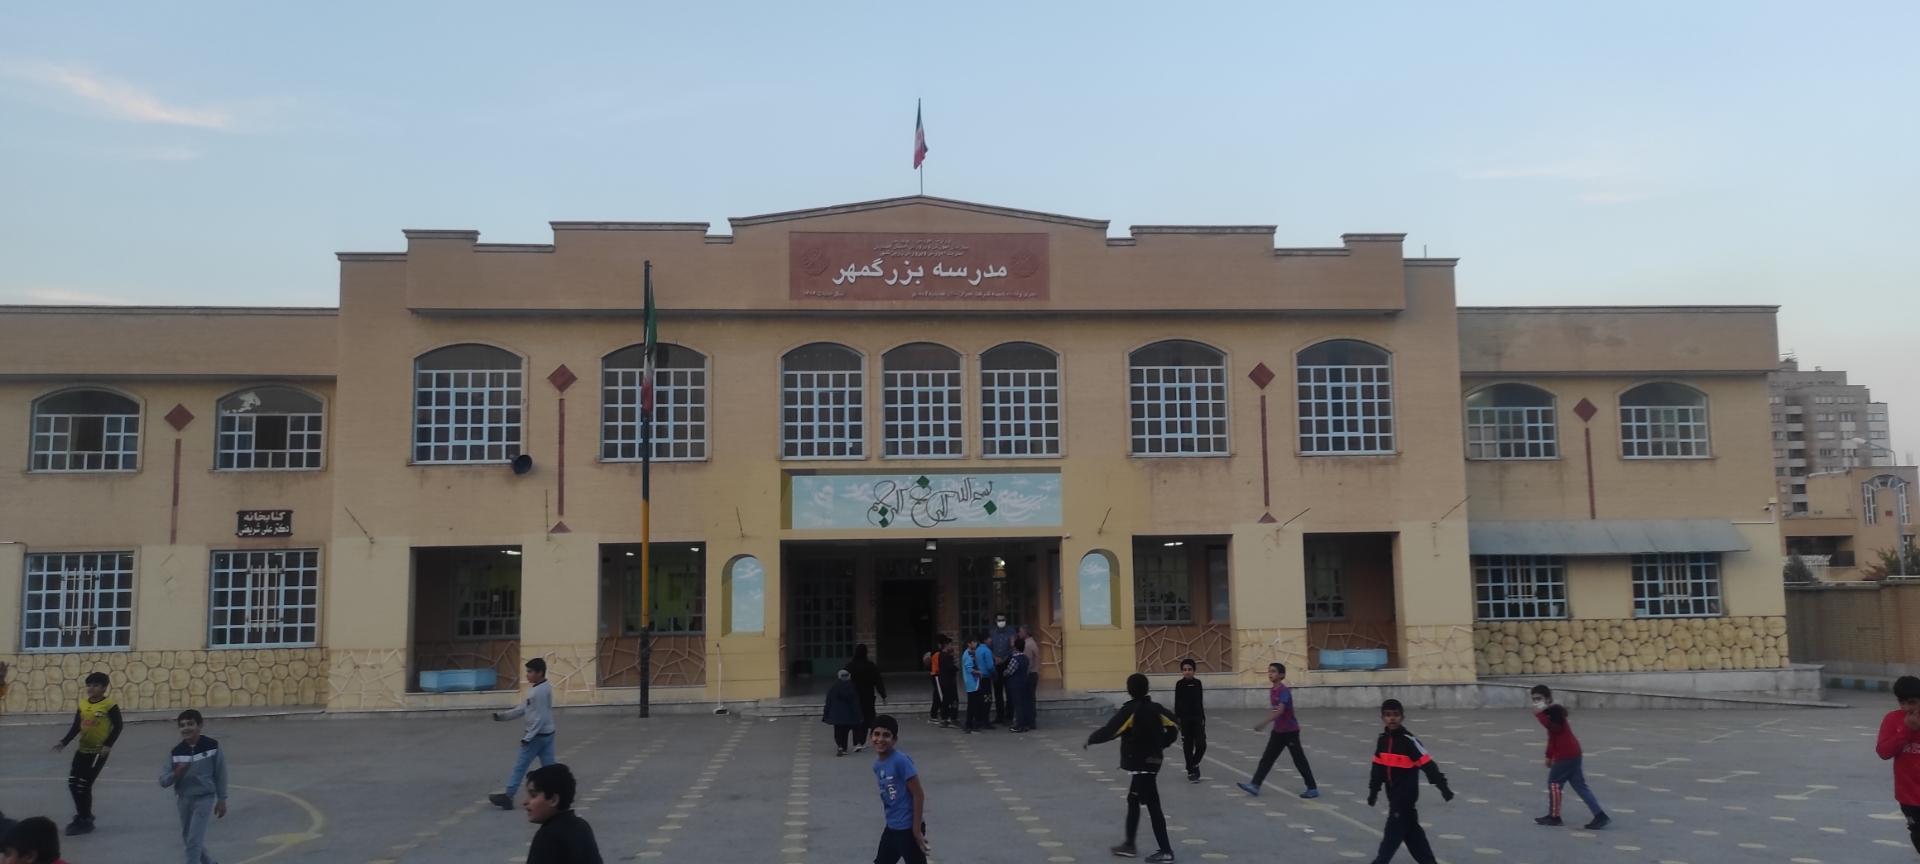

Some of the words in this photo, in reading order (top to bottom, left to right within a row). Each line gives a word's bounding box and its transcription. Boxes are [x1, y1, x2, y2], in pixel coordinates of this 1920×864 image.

[832, 257, 924, 286] بزرگمهر
[932, 261, 1008, 286] مدرسه
[243, 511, 286, 521] کتابخانه
[273, 522, 290, 535] دکتر
